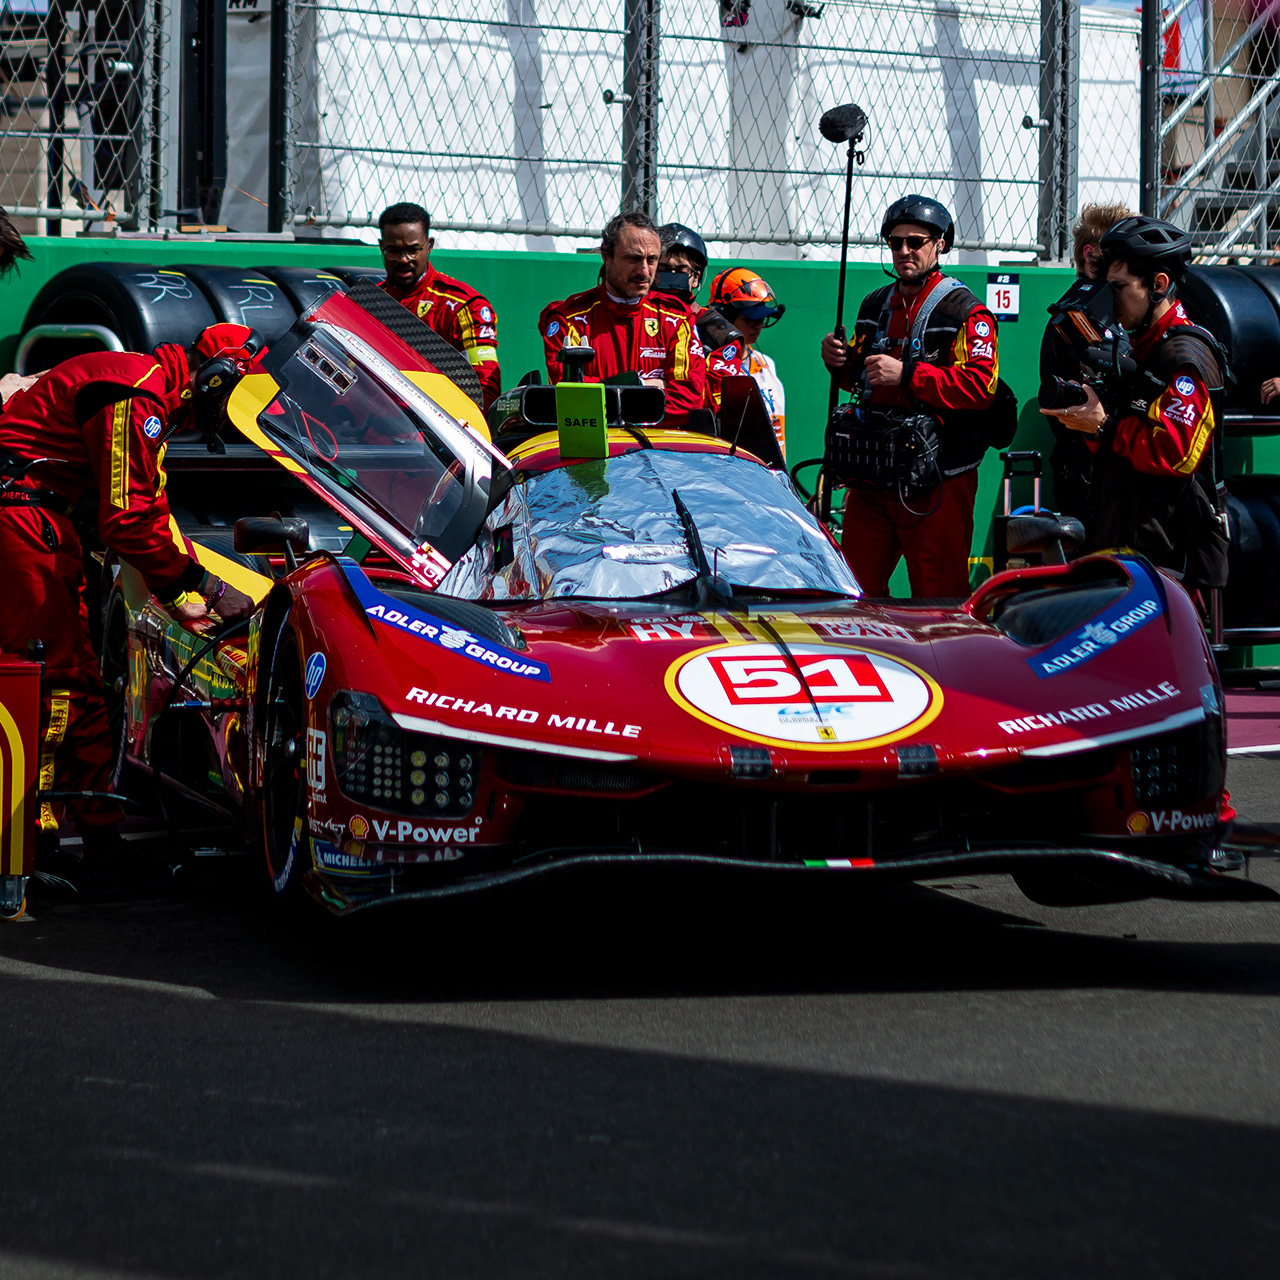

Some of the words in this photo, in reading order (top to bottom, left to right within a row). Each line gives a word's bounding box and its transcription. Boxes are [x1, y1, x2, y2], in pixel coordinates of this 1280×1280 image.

[995, 290, 1011, 309] 15
[144, 416, 162, 439] hp
[564, 417, 598, 428] SAFE
[365, 604, 438, 640] ADLER
[464, 643, 541, 677] GROUP
[630, 622, 695, 642] HY
[1040, 639, 1101, 674] ADLER
[1109, 599, 1159, 635] GROUP
[305, 652, 326, 700] hp
[719, 657, 883, 700] 51
[405, 686, 540, 724] RICHARD
[546, 714, 642, 738] MILLE
[998, 702, 1112, 735] RICHARD
[1109, 681, 1182, 713] MILLE
[371, 819, 480, 842] V-Power
